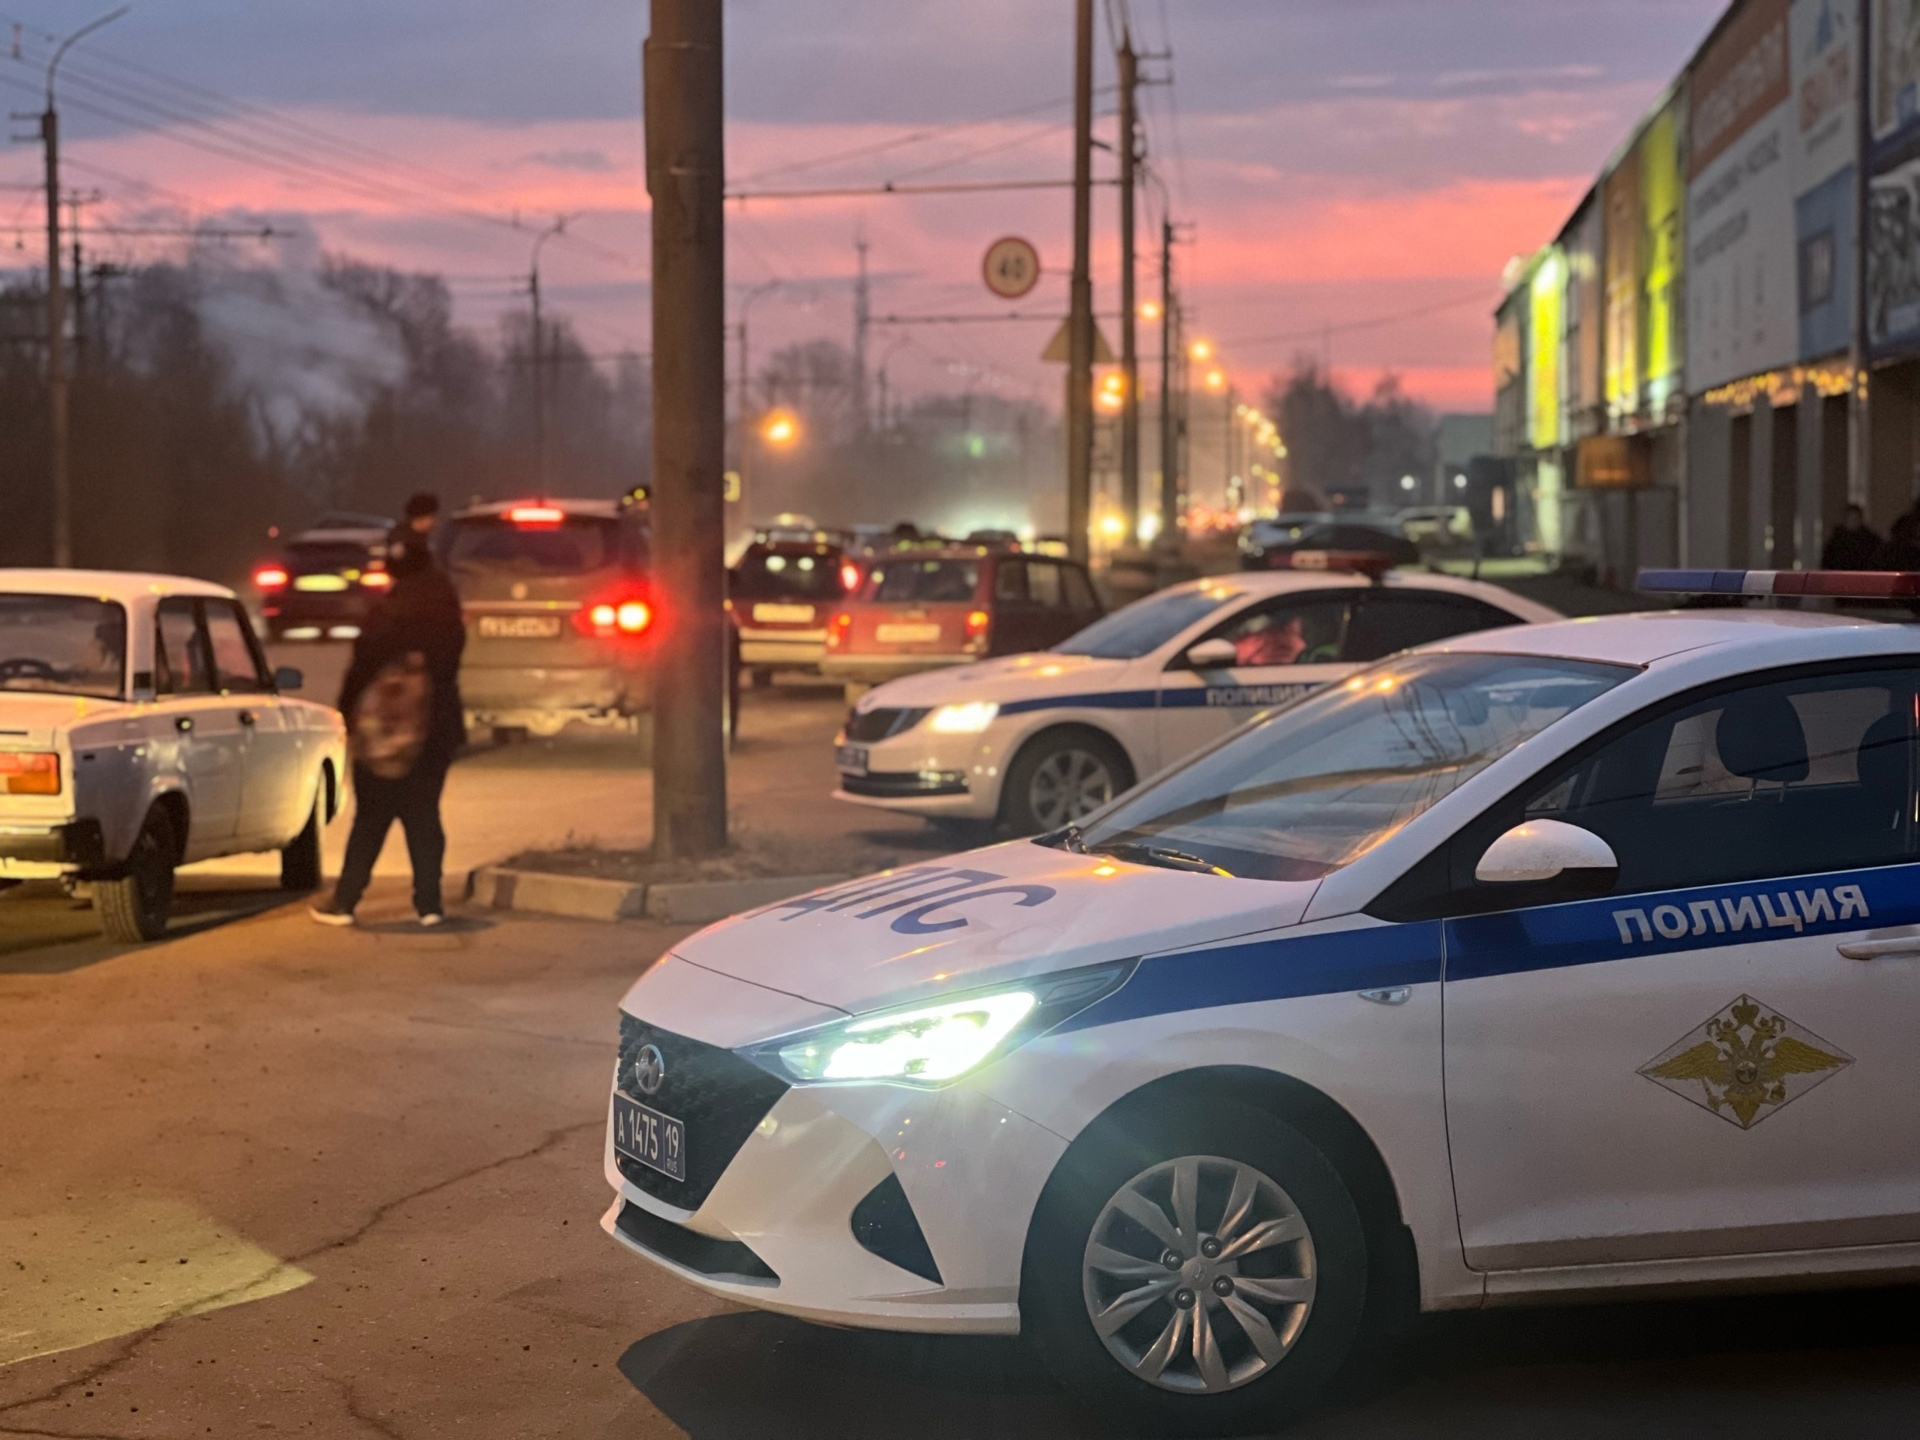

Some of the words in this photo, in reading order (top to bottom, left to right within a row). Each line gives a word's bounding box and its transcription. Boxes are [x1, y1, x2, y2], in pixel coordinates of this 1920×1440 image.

[998, 256, 1026, 280] 40
[746, 866, 1057, 935] ДПС
[1612, 884, 1870, 945] ПОЛИЦИЯ
[629, 1108, 658, 1160] 1475
[665, 1123, 679, 1158] 19
